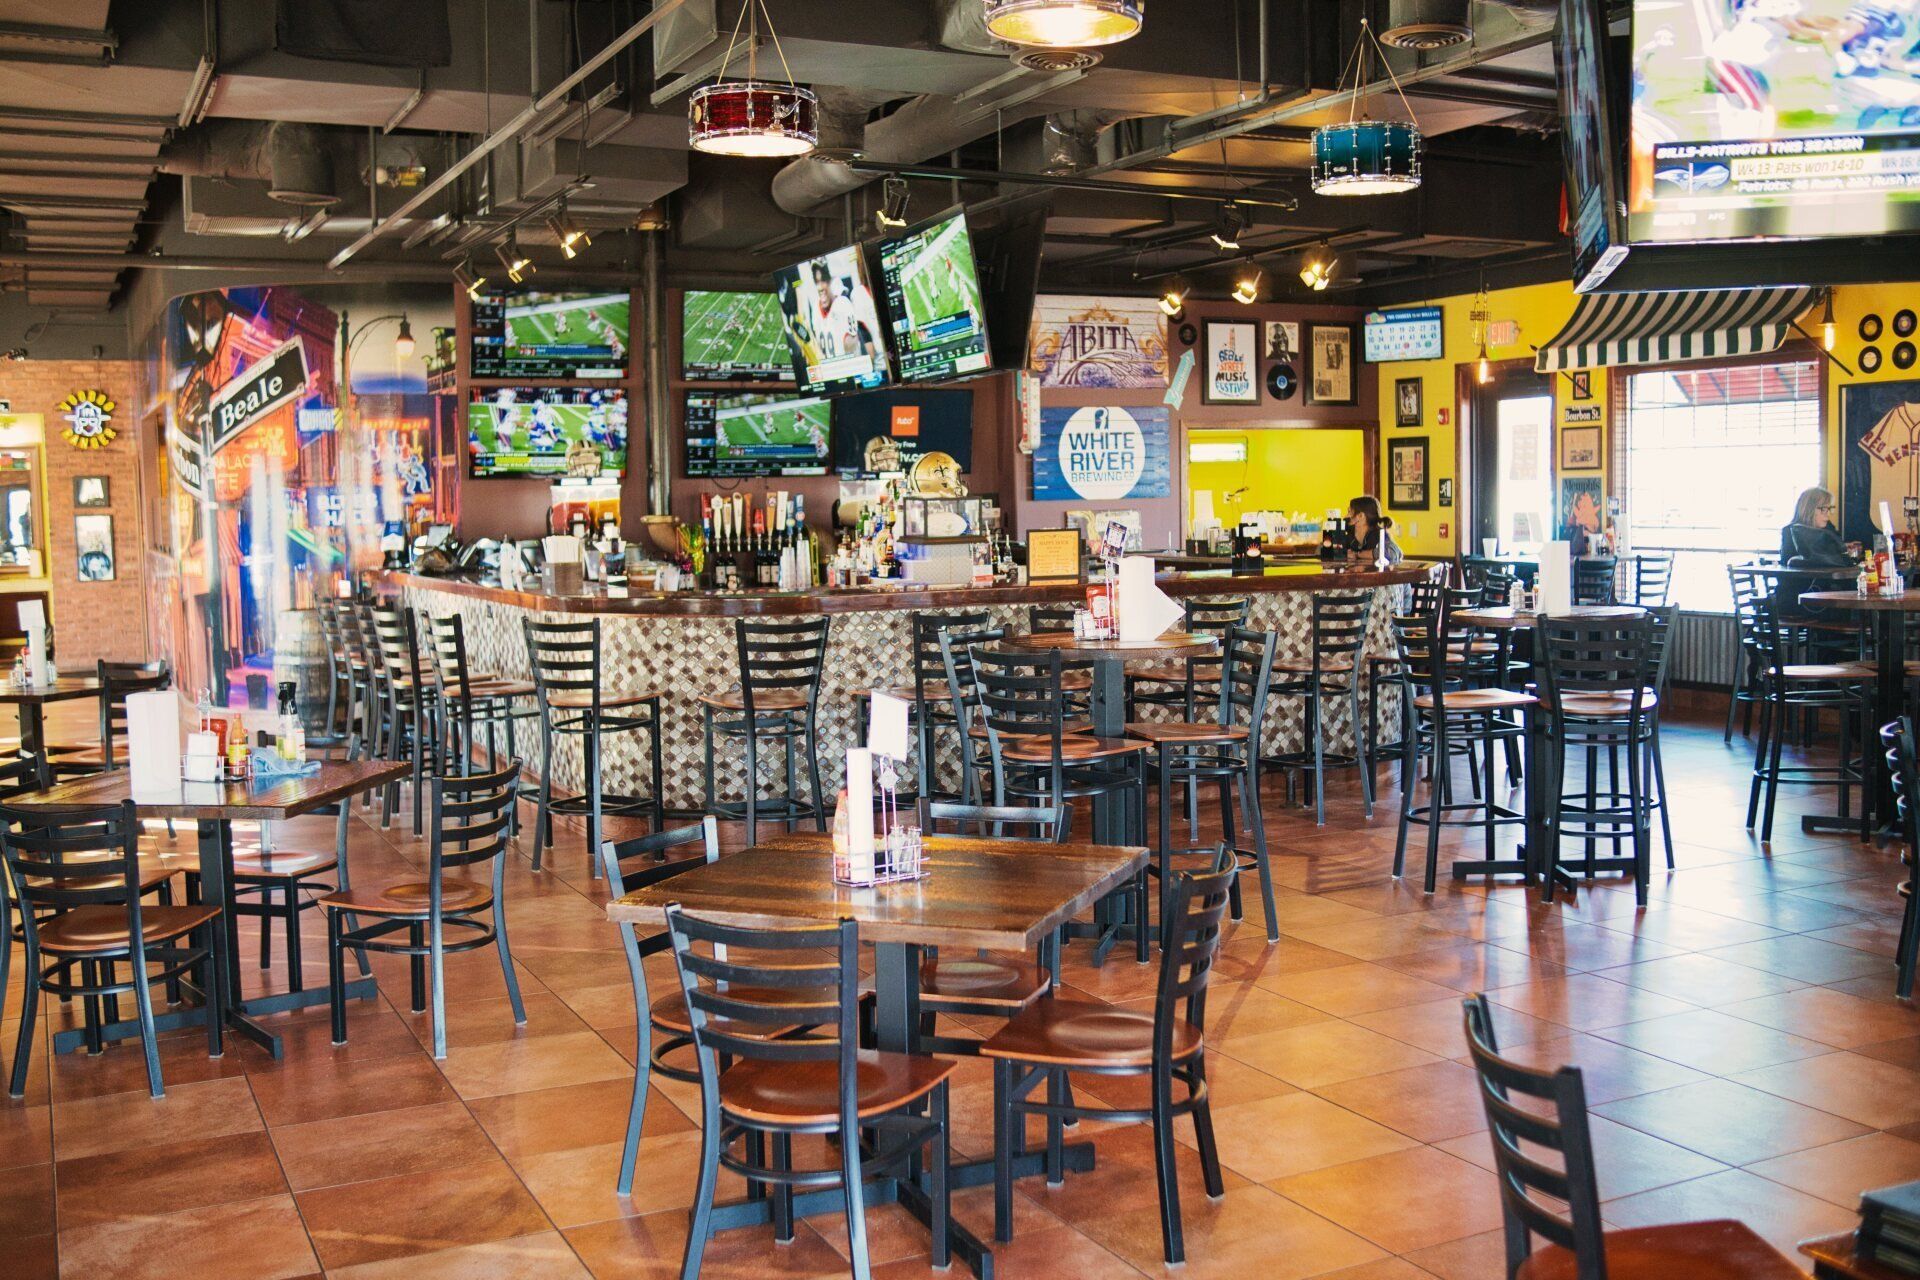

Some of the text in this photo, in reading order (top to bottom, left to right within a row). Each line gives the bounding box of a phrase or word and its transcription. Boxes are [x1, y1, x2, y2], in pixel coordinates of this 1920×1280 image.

[1804, 137, 1865, 153] SEASON
[1775, 161, 1802, 175] Pats
[1804, 161, 1829, 173] won
[1830, 158, 1865, 171] 14-10
[1490, 321, 1511, 345] EXIT
[1057, 324, 1138, 377] ABITA
[219, 375, 284, 434] Beale
[1565, 408, 1591, 422] Bourbon
[1068, 432, 1136, 450] WHITE
[1070, 453, 1135, 471] RIVER
[1071, 472, 1123, 483] BREWING
[1563, 479, 1601, 492] Memphis
